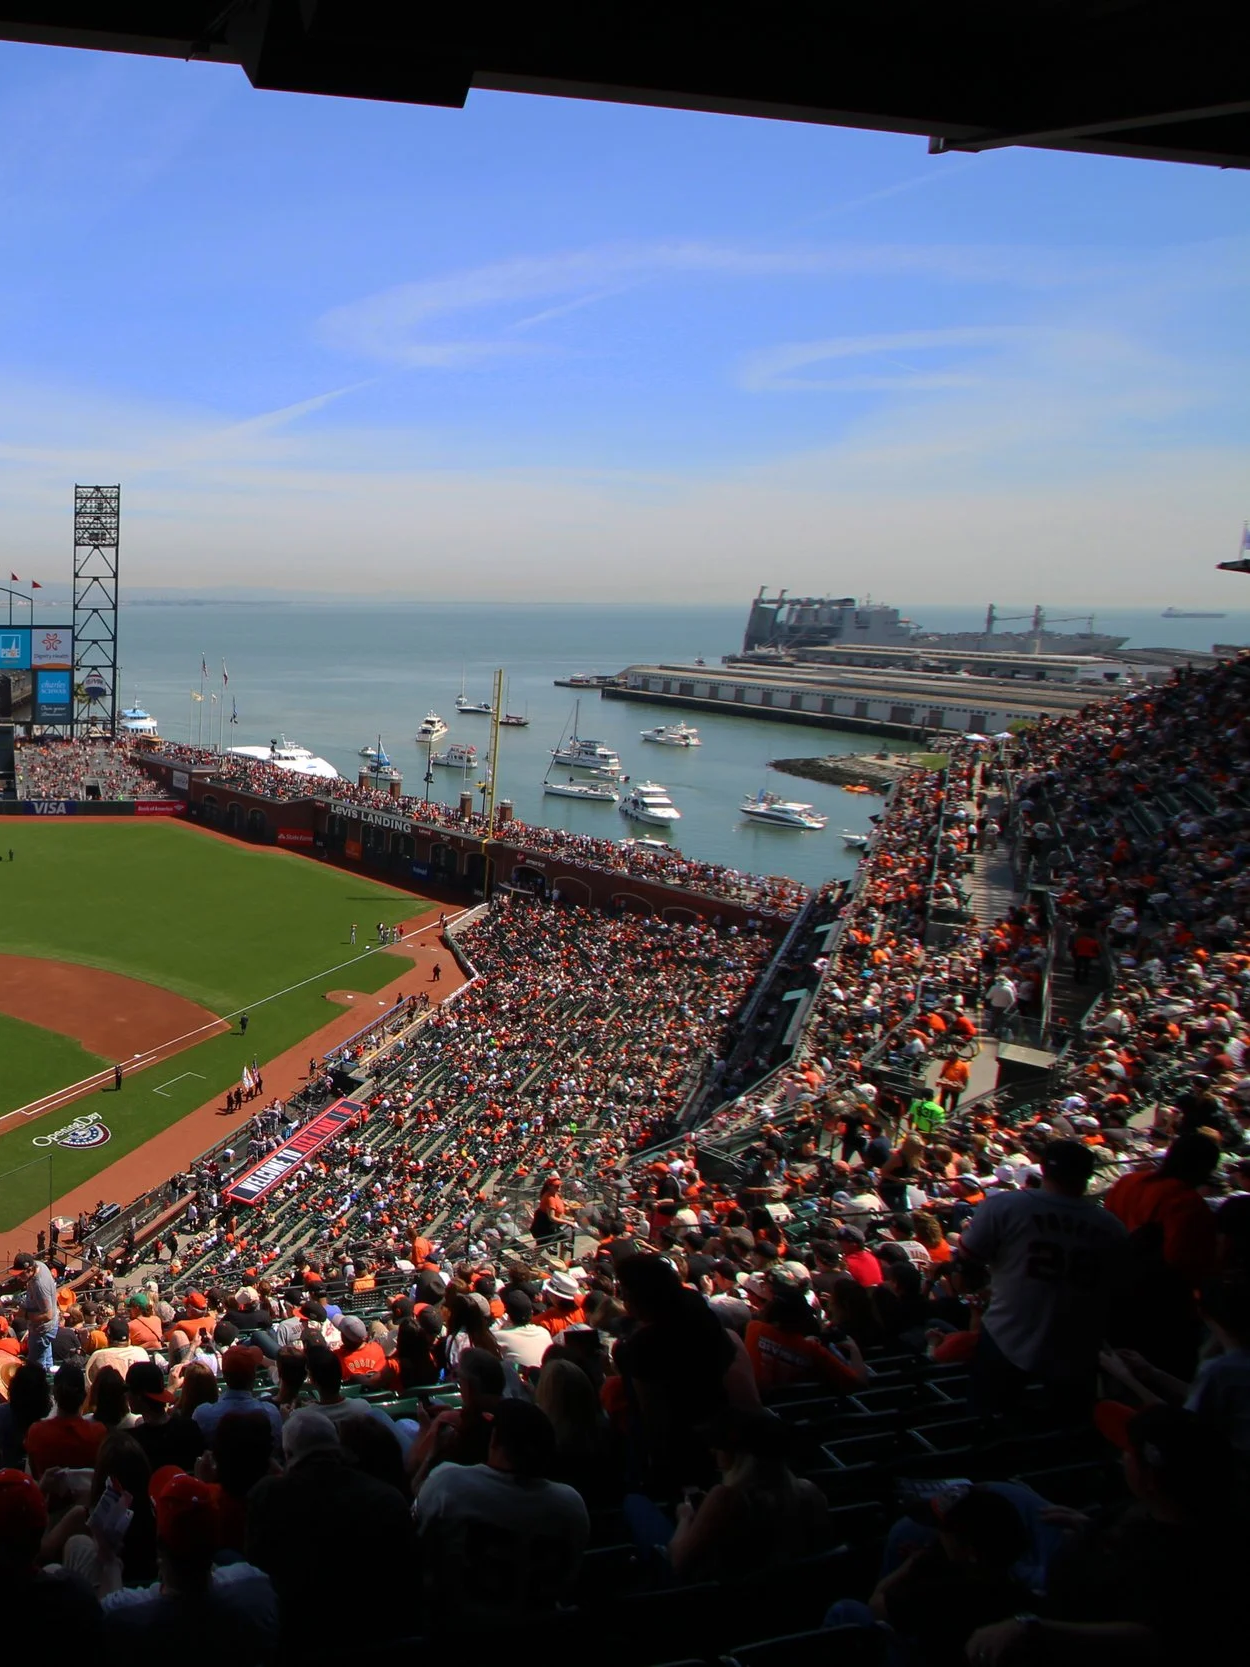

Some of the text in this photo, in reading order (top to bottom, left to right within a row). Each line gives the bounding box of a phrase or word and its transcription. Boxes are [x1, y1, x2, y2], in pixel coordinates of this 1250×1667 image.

[33, 802, 67, 814] VISA
[361, 812, 411, 833] LANDING
[237, 1157, 293, 1193] WELCOME
[348, 1359, 377, 1372] POSEY
